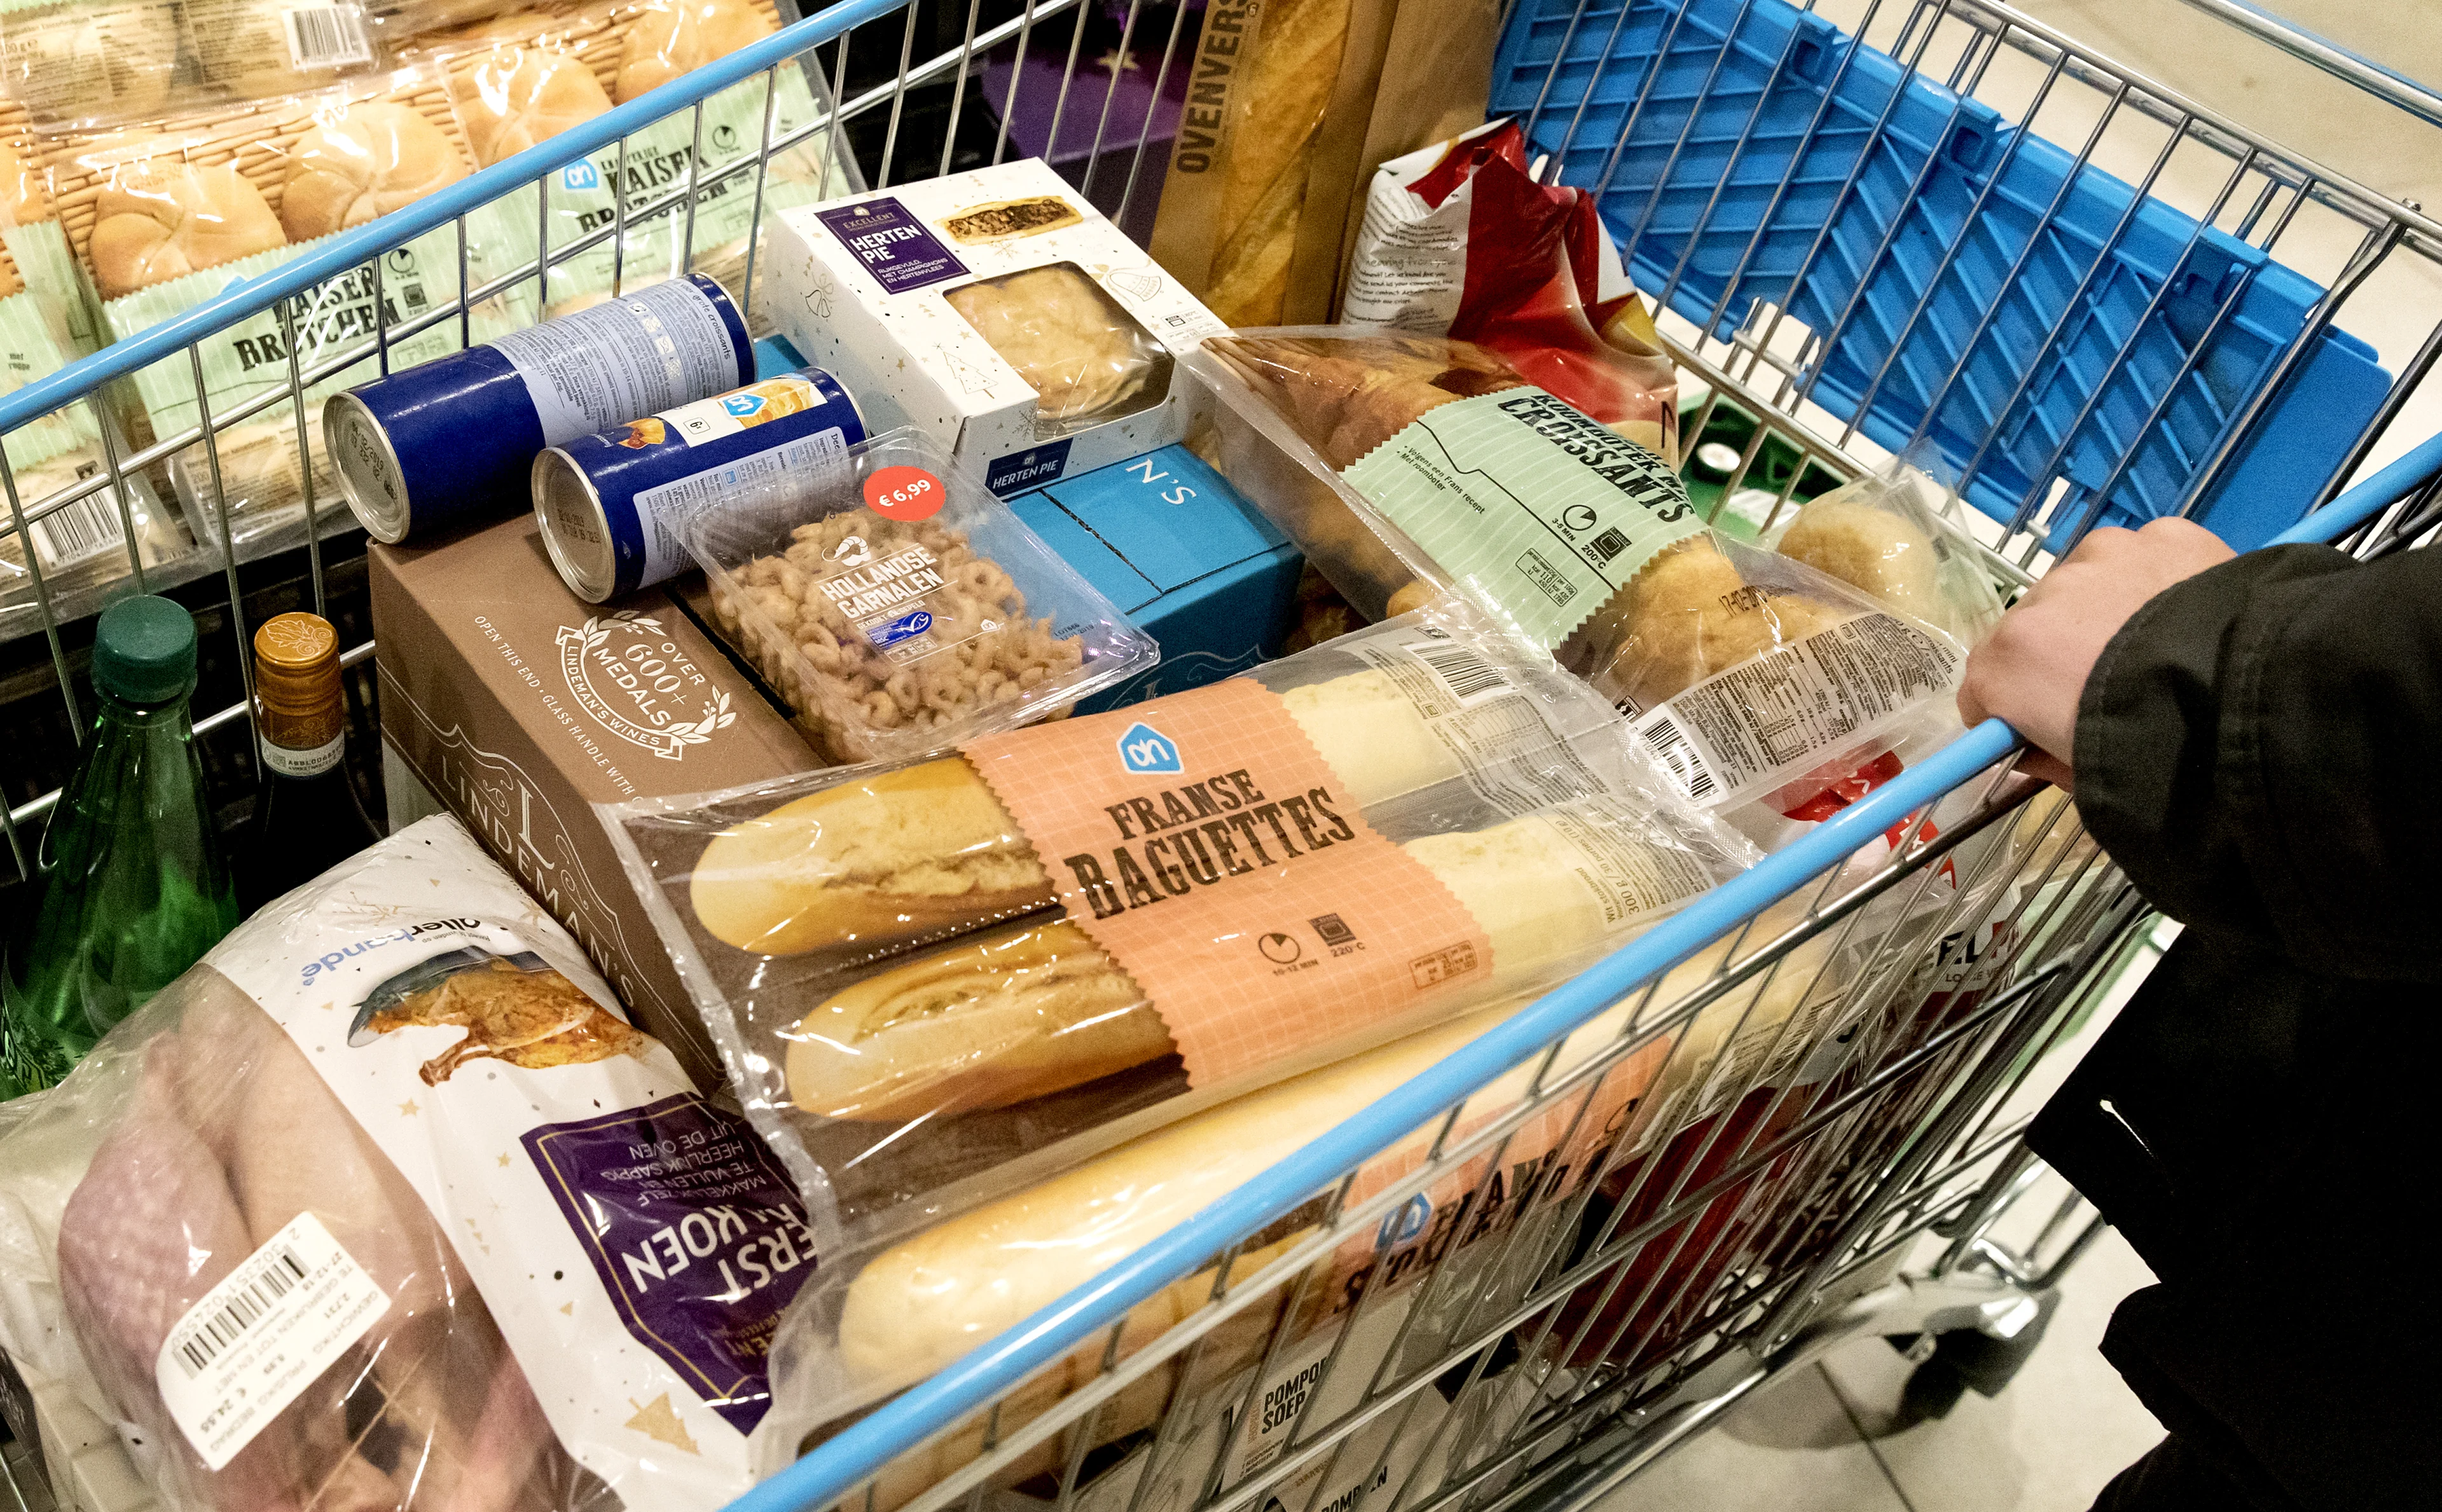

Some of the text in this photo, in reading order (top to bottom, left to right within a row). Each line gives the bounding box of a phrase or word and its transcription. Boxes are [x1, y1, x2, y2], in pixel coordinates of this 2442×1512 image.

[843, 212, 897, 229] EXCELLENT
[849, 224, 922, 251] HERTEN
[861, 246, 895, 264] PIE
[883, 258, 948, 279] MET CHAMPIGNONS
[898, 265, 944, 282] HERTENVLEES
[692, 295, 731, 361] grote croissants
[555, 381, 563, 392] dag.
[558, 375, 574, 402] gemiddelde
[586, 366, 595, 378] 1450
[621, 368, 631, 382] 10-14
[572, 376, 591, 416] Deze verpakking
[573, 394, 581, 408] bevat
[1531, 395, 1661, 472] ROOMBOTER
[993, 460, 1058, 489] HERTEN PIE
[1400, 451, 1447, 492] Met roomboter
[1498, 398, 1695, 523] CROISSANTS
[682, 483, 691, 499] vezels
[879, 479, 932, 507] € 6,99
[1407, 446, 1486, 516] Volgens een Frans recept
[651, 494, 659, 507] 1506
[657, 491, 666, 507] Albert
[1550, 517, 1576, 542] 3-5 MIN
[1579, 543, 1608, 570] 200°C
[820, 547, 937, 601] HOLLANDSE
[1531, 564, 1553, 584] kcal 110
[1537, 579, 1547, 588] 450
[1562, 583, 1575, 595] 100g
[837, 568, 944, 619] GARNALEN
[1552, 593, 1564, 605] 1785
[1559, 590, 1569, 600] 430
[857, 615, 887, 629] GEKOOKT
[900, 600, 926, 614] GEPELD
[661, 642, 705, 686] OVER
[1924, 631, 1954, 676] croissants
[1942, 644, 1958, 664] mini
[592, 647, 672, 726] MEDALS
[624, 643, 687, 706] 600+
[1708, 682, 1716, 691] AH
[474, 615, 632, 797] OPEN THIS END GLASS HANDLE WITH
[566, 645, 661, 746] LINDEMAN'S WINES
[1677, 697, 1691, 712] 1506
[1692, 715, 1711, 742] ZAANDAM,
[1708, 738, 1727, 764] Nederland
[1837, 708, 1854, 732] croissant
[1103, 769, 1266, 841] FRANSE
[1063, 787, 1355, 920] BAGUETTES
[1581, 838, 1603, 862] porties
[442, 755, 633, 1007] LINDEMAN'S
[1599, 862, 1610, 873] 30
[1617, 879, 1628, 888] g
[1576, 867, 1616, 923] Wit stokbrood
[1621, 890, 1639, 914] 300
[629, 1120, 736, 1160] UIT DE OVEN
[600, 1141, 744, 1182] HEERLIJK SAPPIG
[639, 1161, 754, 1190] TE VULLEN EN
[621, 1202, 797, 1295] KKOEN
[718, 1224, 818, 1305] ERST
[167, 1227, 300, 1349] 2 302351 024550
[299, 1251, 345, 1292] 27-12-18
[212, 1262, 354, 1394] TE GEBRUIKEN TOT EN MET
[308, 1288, 383, 1356] GEWICHT/KG
[1264, 1356, 1332, 1413] POMPO
[1262, 1391, 1306, 1434] SOEP
[206, 1406, 258, 1454] BEDRAG
[1321, 1466, 1388, 1512] POMPN
